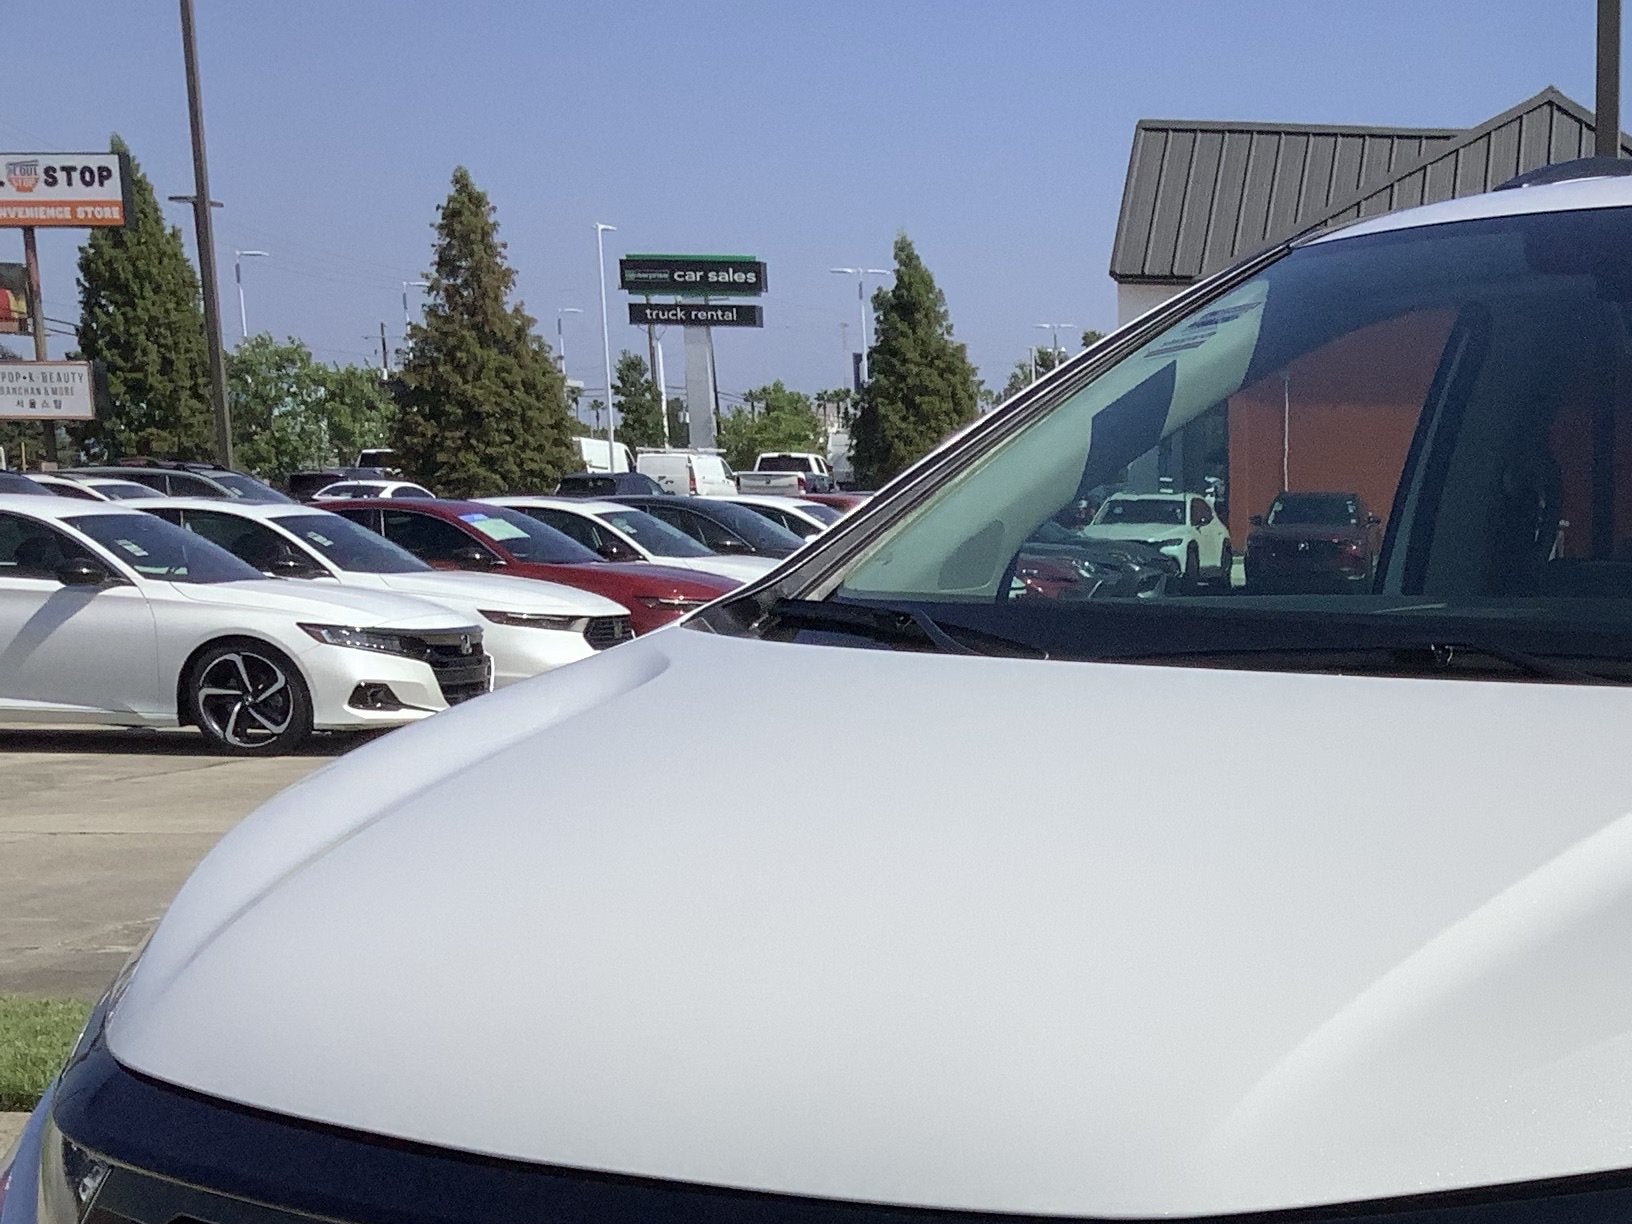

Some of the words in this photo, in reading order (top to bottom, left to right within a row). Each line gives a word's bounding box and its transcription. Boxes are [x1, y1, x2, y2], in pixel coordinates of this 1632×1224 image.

[43, 165, 112, 187] STOP
[76, 206, 120, 219] STORE
[673, 270, 704, 282] car
[708, 267, 757, 283] sales
[645, 306, 686, 320] truck
[691, 308, 737, 321] rental
